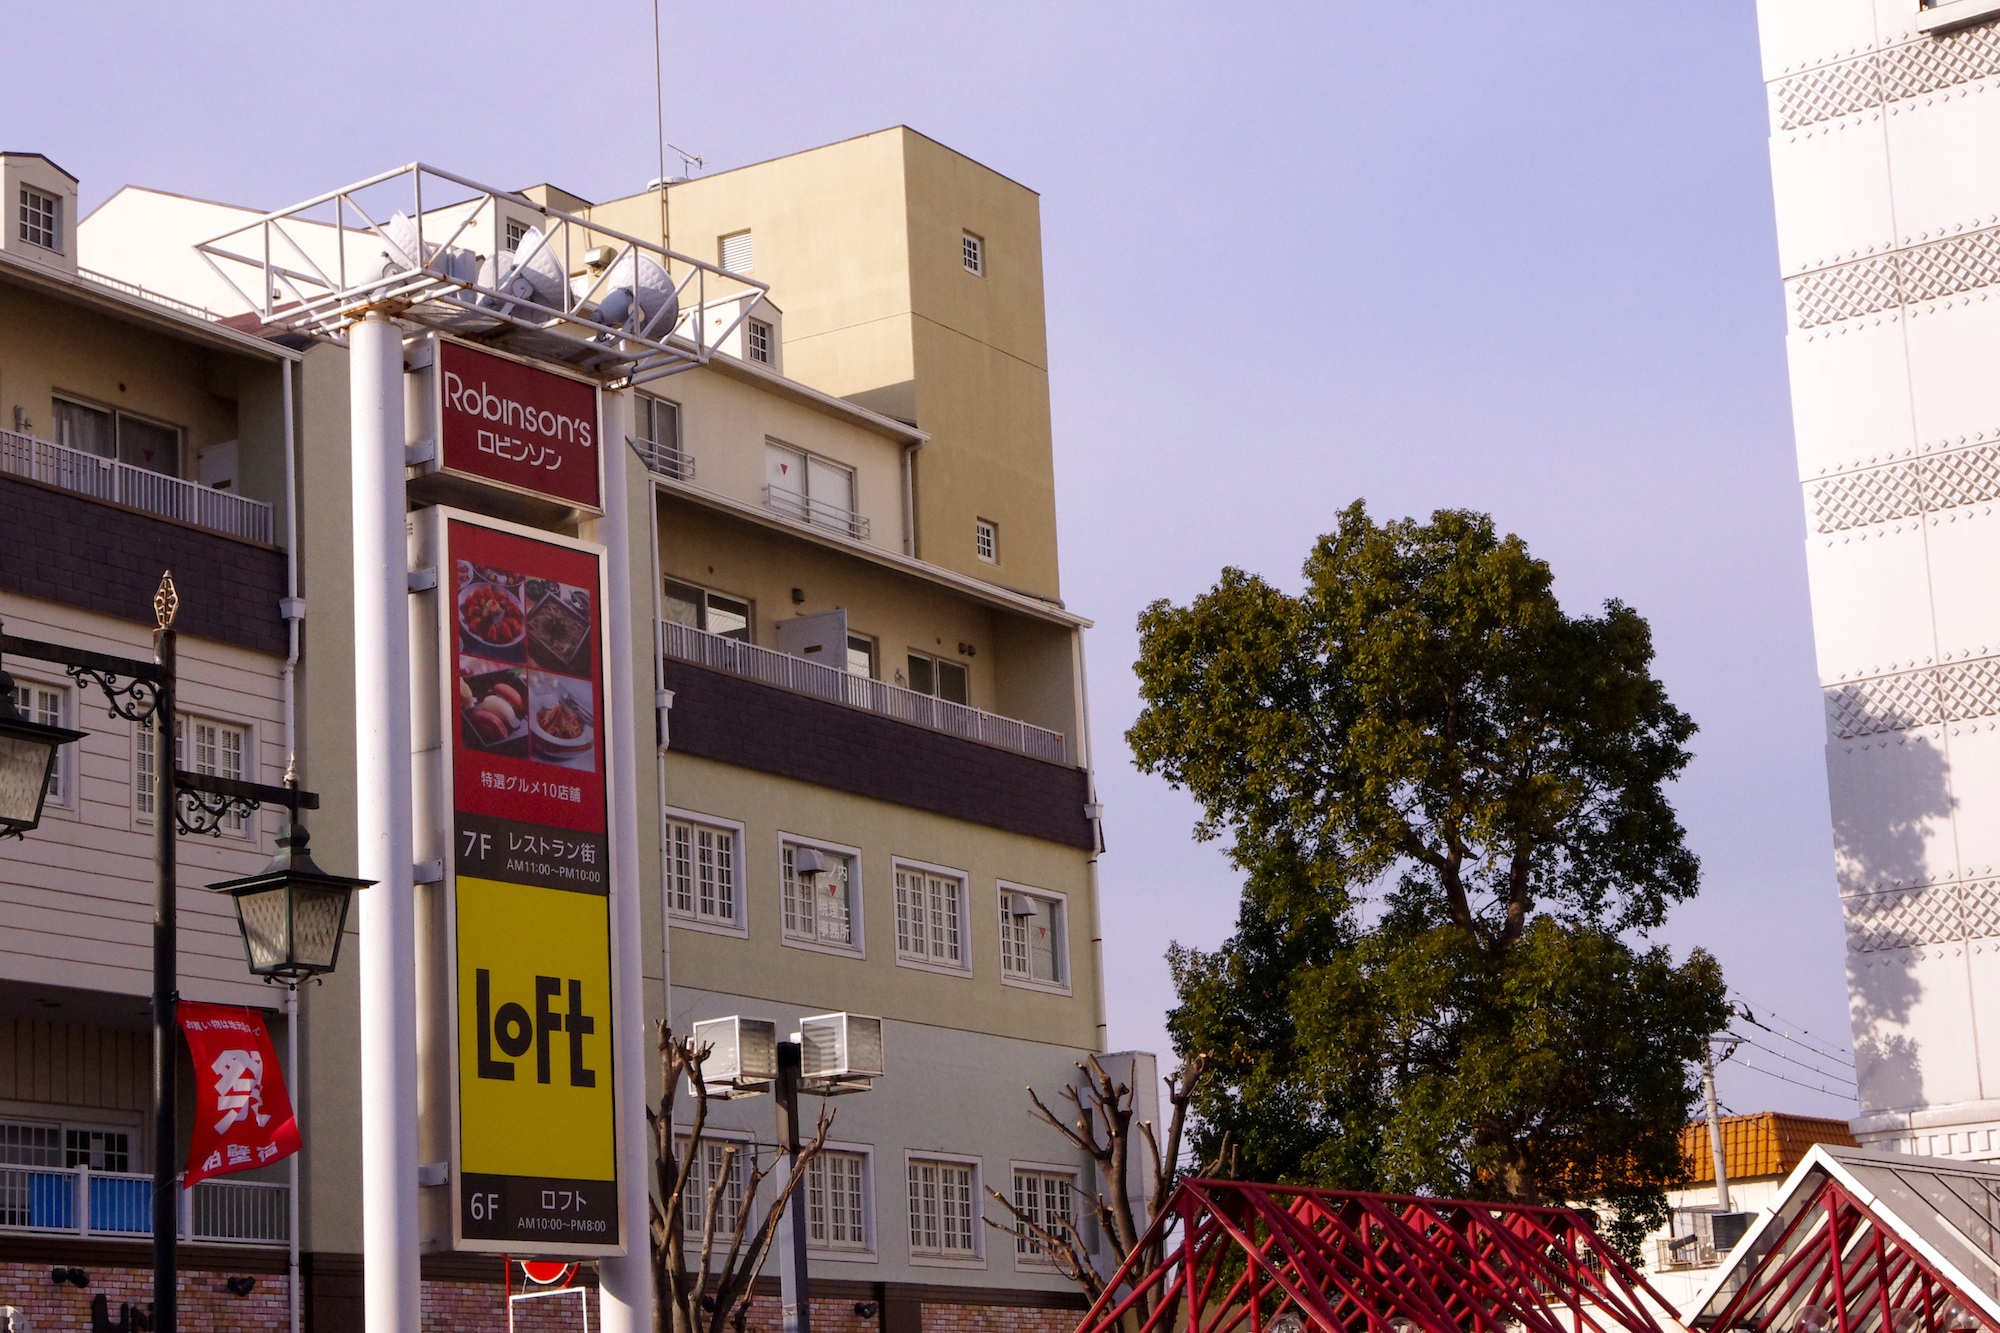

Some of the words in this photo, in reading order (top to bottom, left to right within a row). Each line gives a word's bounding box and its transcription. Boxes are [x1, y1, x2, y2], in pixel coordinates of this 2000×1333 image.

[444, 371, 592, 447] Robinson's
[477, 429, 562, 471] ロビンソン
[480, 771, 581, 803] 特選グルメ10店舗
[462, 831, 492, 861] 7F
[508, 832, 596, 864] レストラン街
[819, 863, 848, 882] ノ内
[818, 900, 849, 921] 税理士
[819, 920, 850, 941] 事務所
[470, 1192, 499, 1221] 6F
[541, 1190, 587, 1212] ロフト
